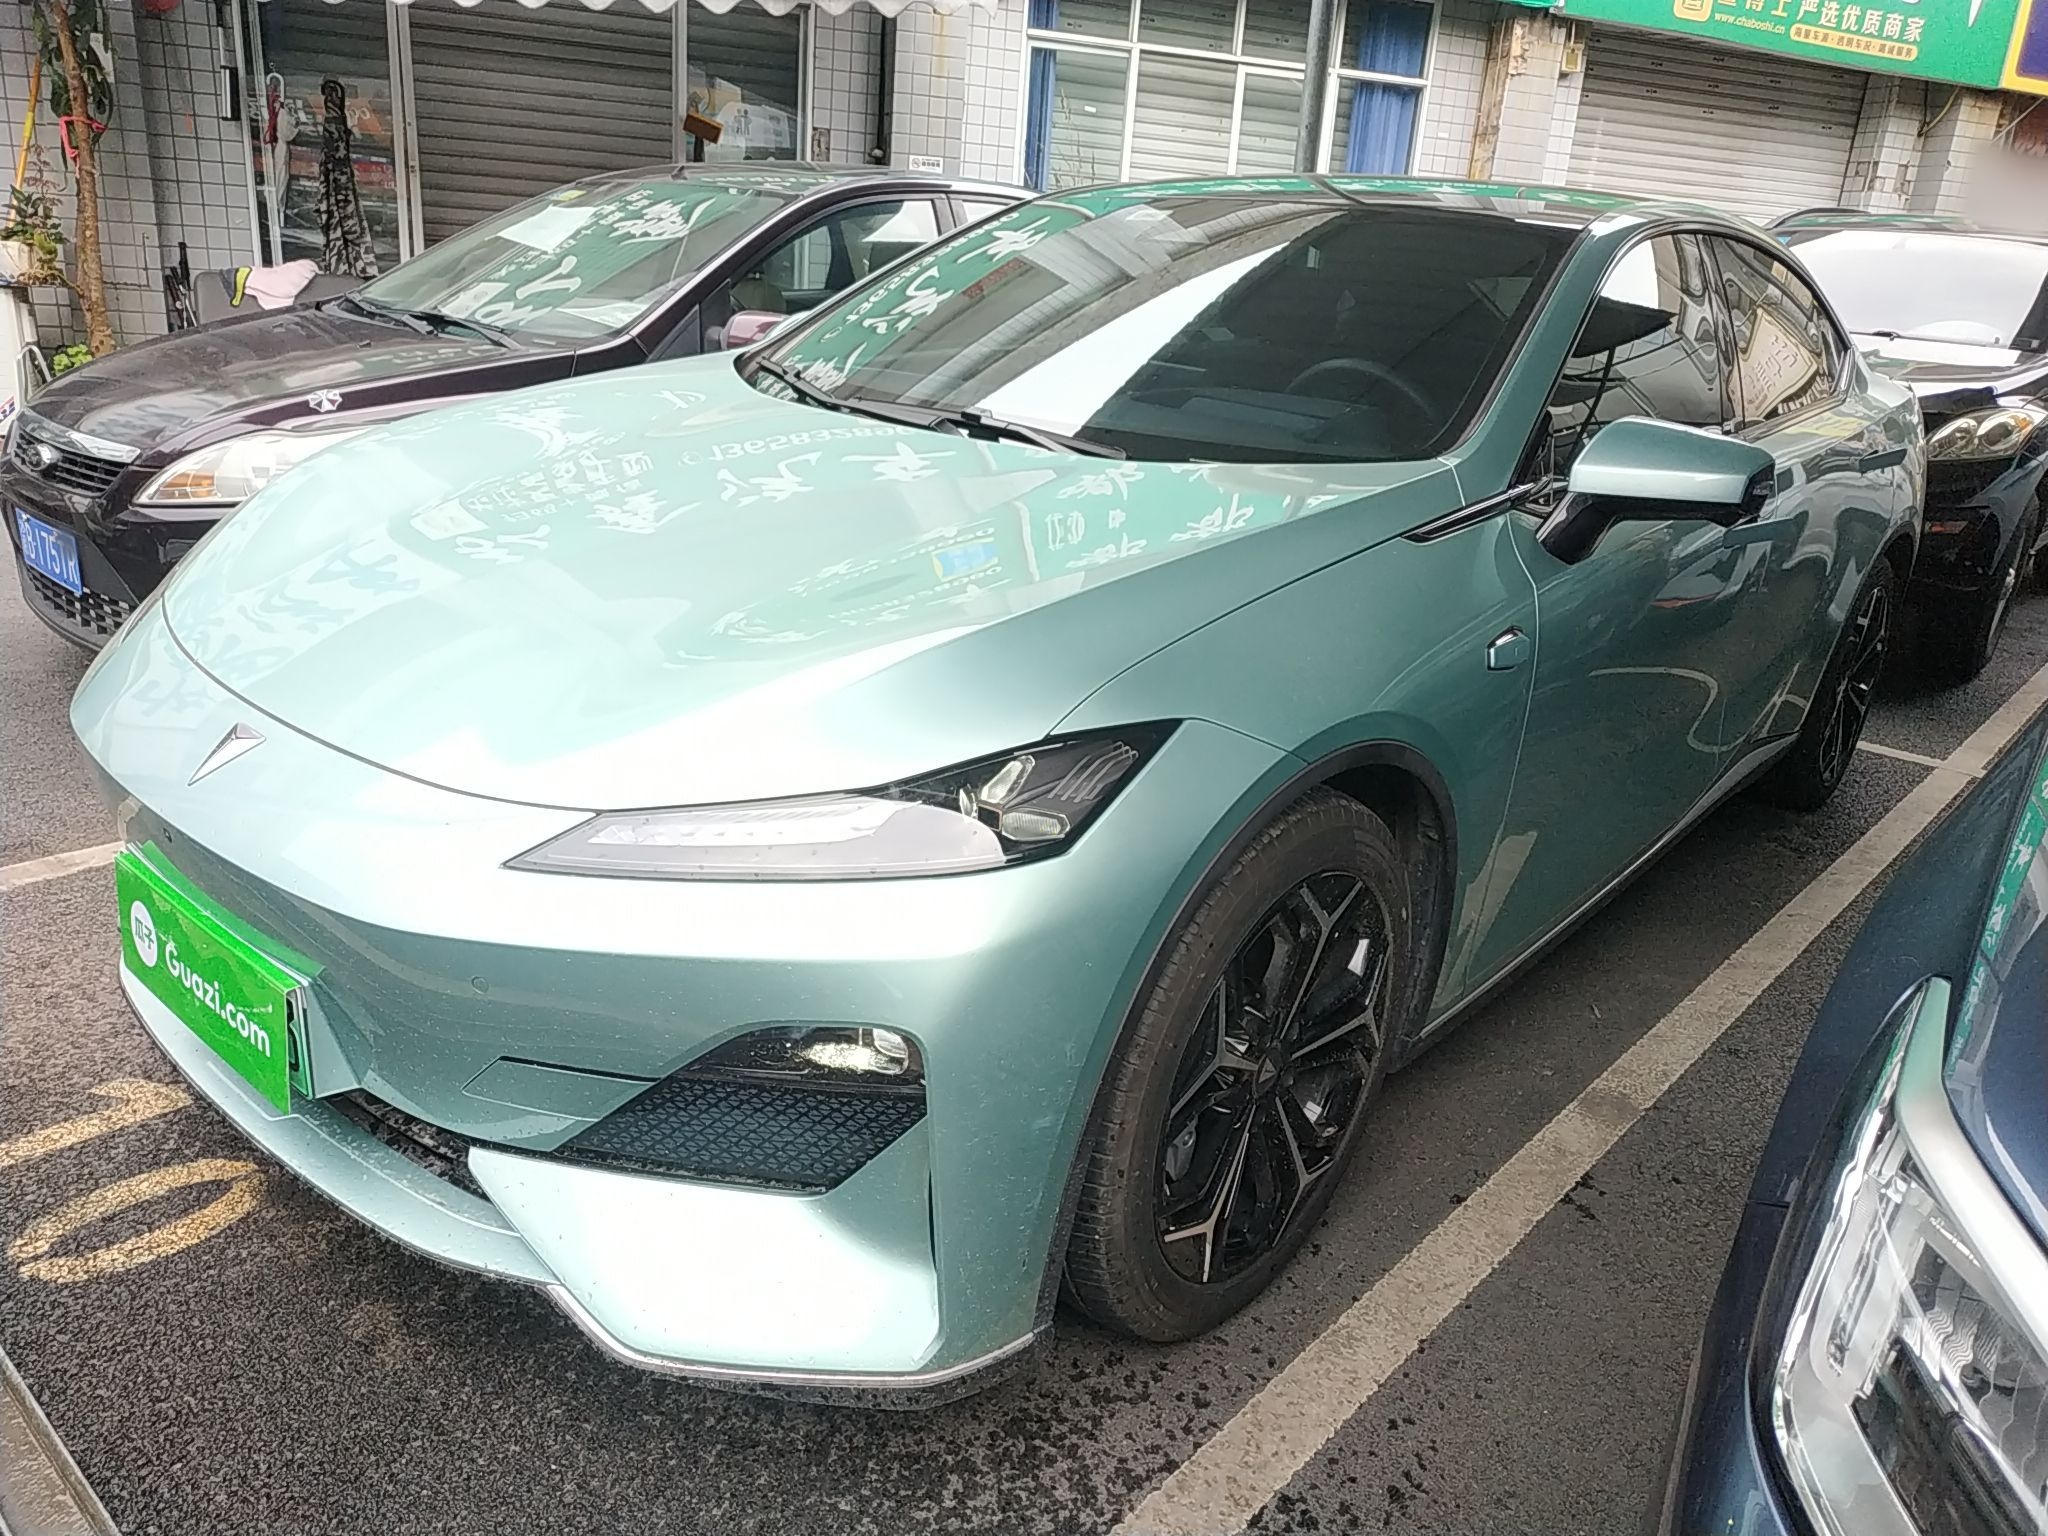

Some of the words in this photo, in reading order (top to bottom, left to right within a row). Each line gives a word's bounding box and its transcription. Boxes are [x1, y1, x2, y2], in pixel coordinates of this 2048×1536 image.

[1714, 12, 1786, 35] www.chaboshi.cn
[134, 915, 155, 950] 瓜子
[165, 942, 271, 1058] Guazi.com
